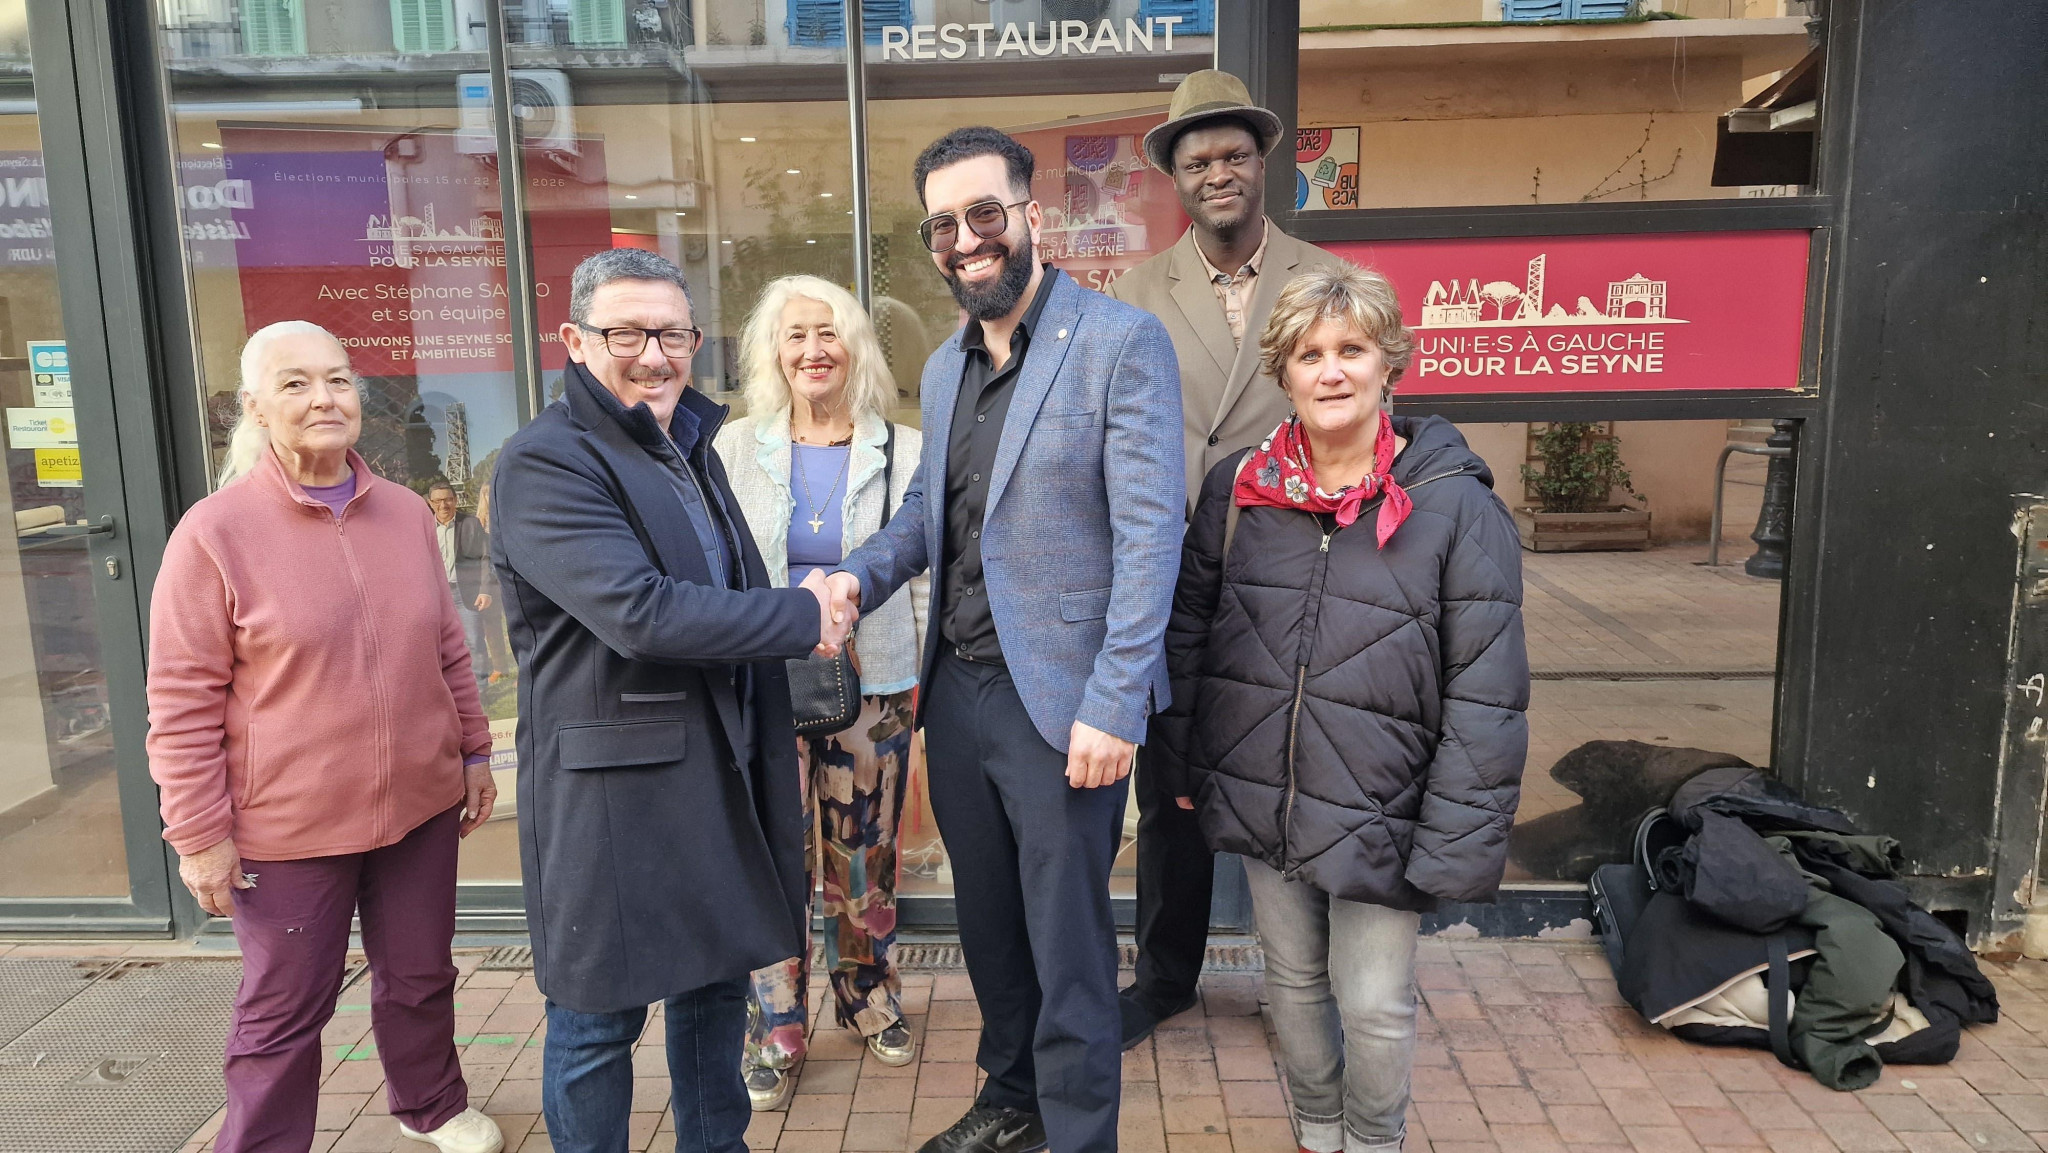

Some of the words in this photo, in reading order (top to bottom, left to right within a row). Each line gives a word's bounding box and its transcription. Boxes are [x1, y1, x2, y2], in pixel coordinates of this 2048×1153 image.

[882, 16, 1182, 60] RESTAURANT
[1046, 160, 1126, 178] municipales
[1129, 155, 1158, 171] 20
[274, 170, 341, 182] Élections
[436, 175, 449, 185] 15
[456, 176, 467, 185] et
[474, 176, 490, 186] 22
[532, 177, 565, 187] 2026
[1071, 231, 1125, 246] GAUCHE
[426, 242, 438, 255] À
[441, 244, 505, 255] GAUCHE
[1058, 247, 1075, 259] LA
[1078, 244, 1124, 258] SEYNE
[369, 256, 420, 268] POUR
[425, 256, 447, 267] LA
[451, 255, 506, 267] SEYNE
[318, 284, 369, 300] Avec
[374, 283, 473, 303] Stéphane
[371, 307, 393, 322] et
[398, 309, 434, 321] son
[440, 305, 506, 324] équipe
[338, 336, 412, 348] ROUVONS
[414, 335, 444, 346] UNE
[447, 334, 493, 345] SEYNE
[1520, 330, 1540, 353] À
[1547, 331, 1665, 352] GAUCHE
[391, 350, 409, 360] ET
[411, 348, 496, 360] AMBITIEUSE
[1419, 356, 1506, 377] POUR
[1514, 356, 1554, 375] LA
[1561, 353, 1664, 375] SEYNE
[41, 455, 80, 469] apetiz
